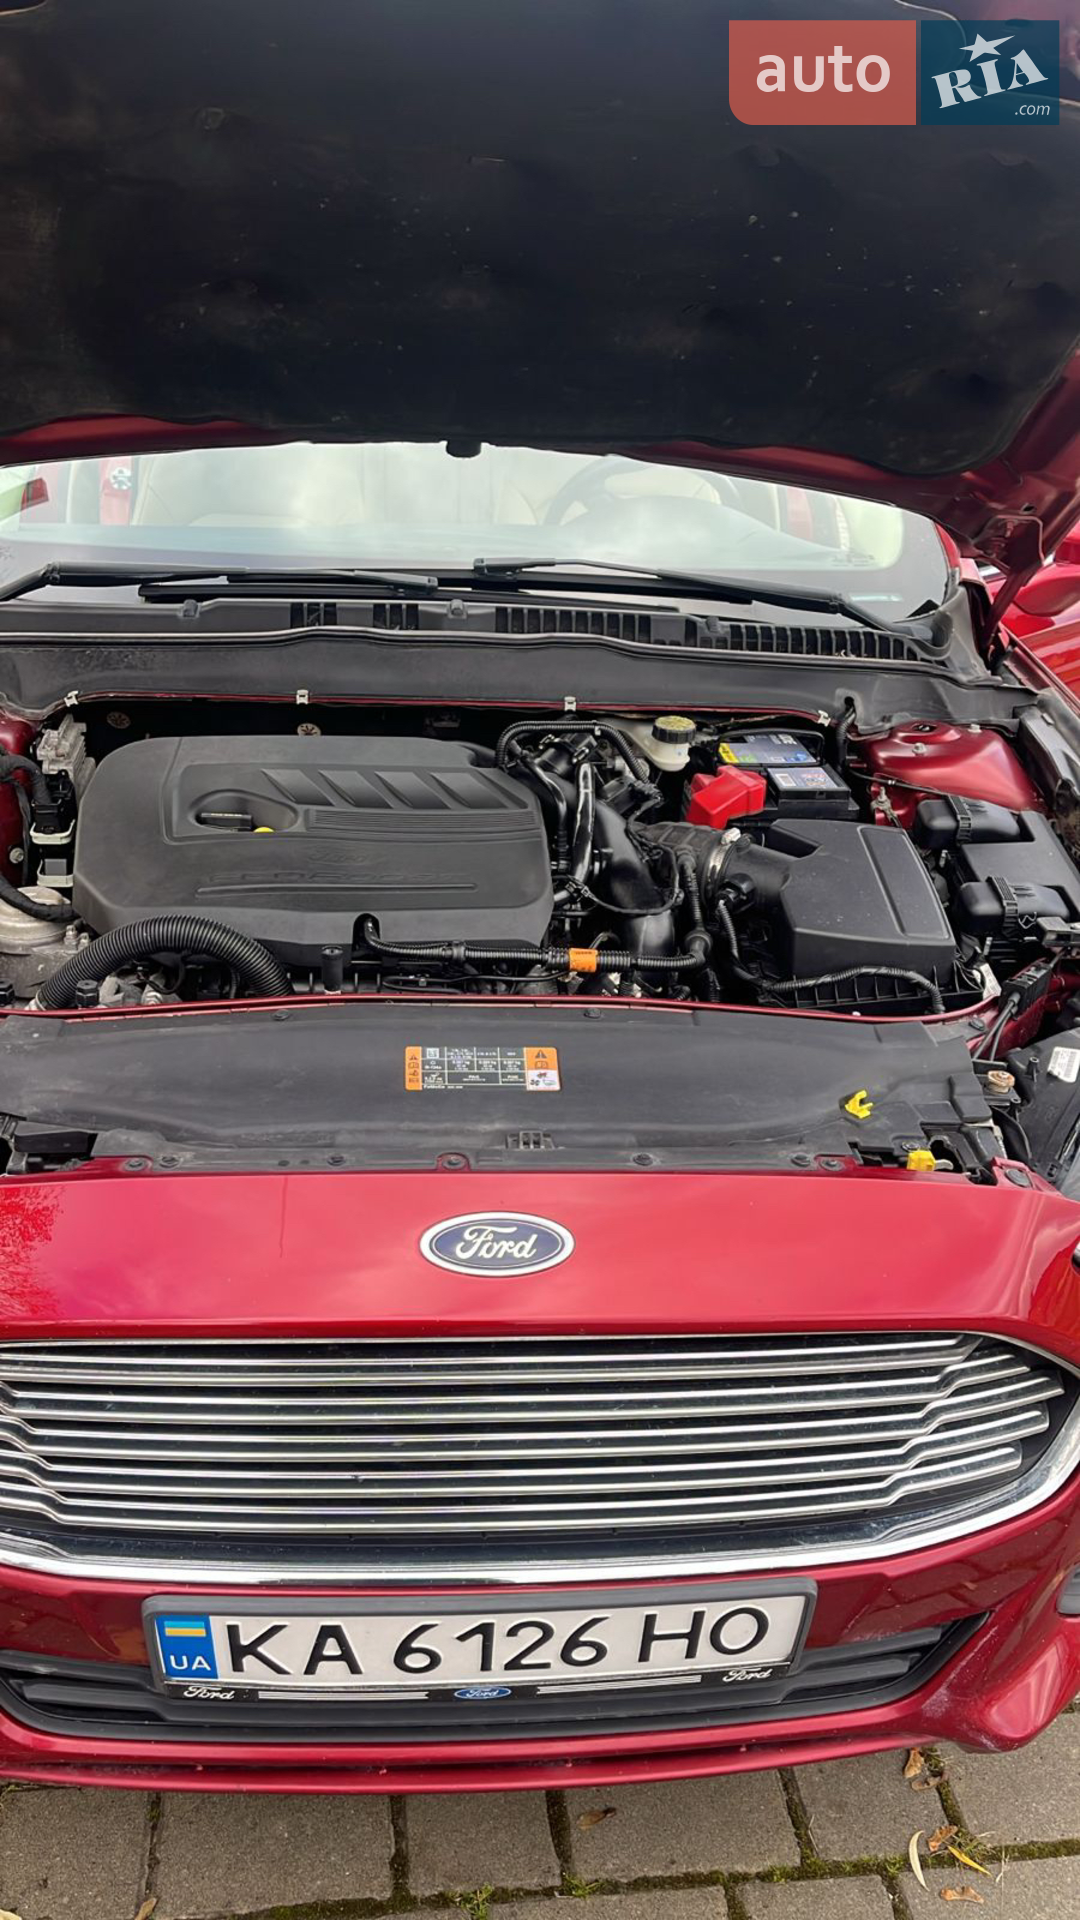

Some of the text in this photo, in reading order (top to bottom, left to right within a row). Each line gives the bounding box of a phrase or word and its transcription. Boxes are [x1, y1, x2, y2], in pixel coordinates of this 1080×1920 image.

[454, 1225, 538, 1260] Ford
[226, 1606, 770, 1675] KA 6126 HO
[169, 1655, 212, 1671] UA
[722, 1667, 773, 1683] Ford
[183, 1685, 235, 1700] Ford
[465, 1687, 501, 1698] Ford
